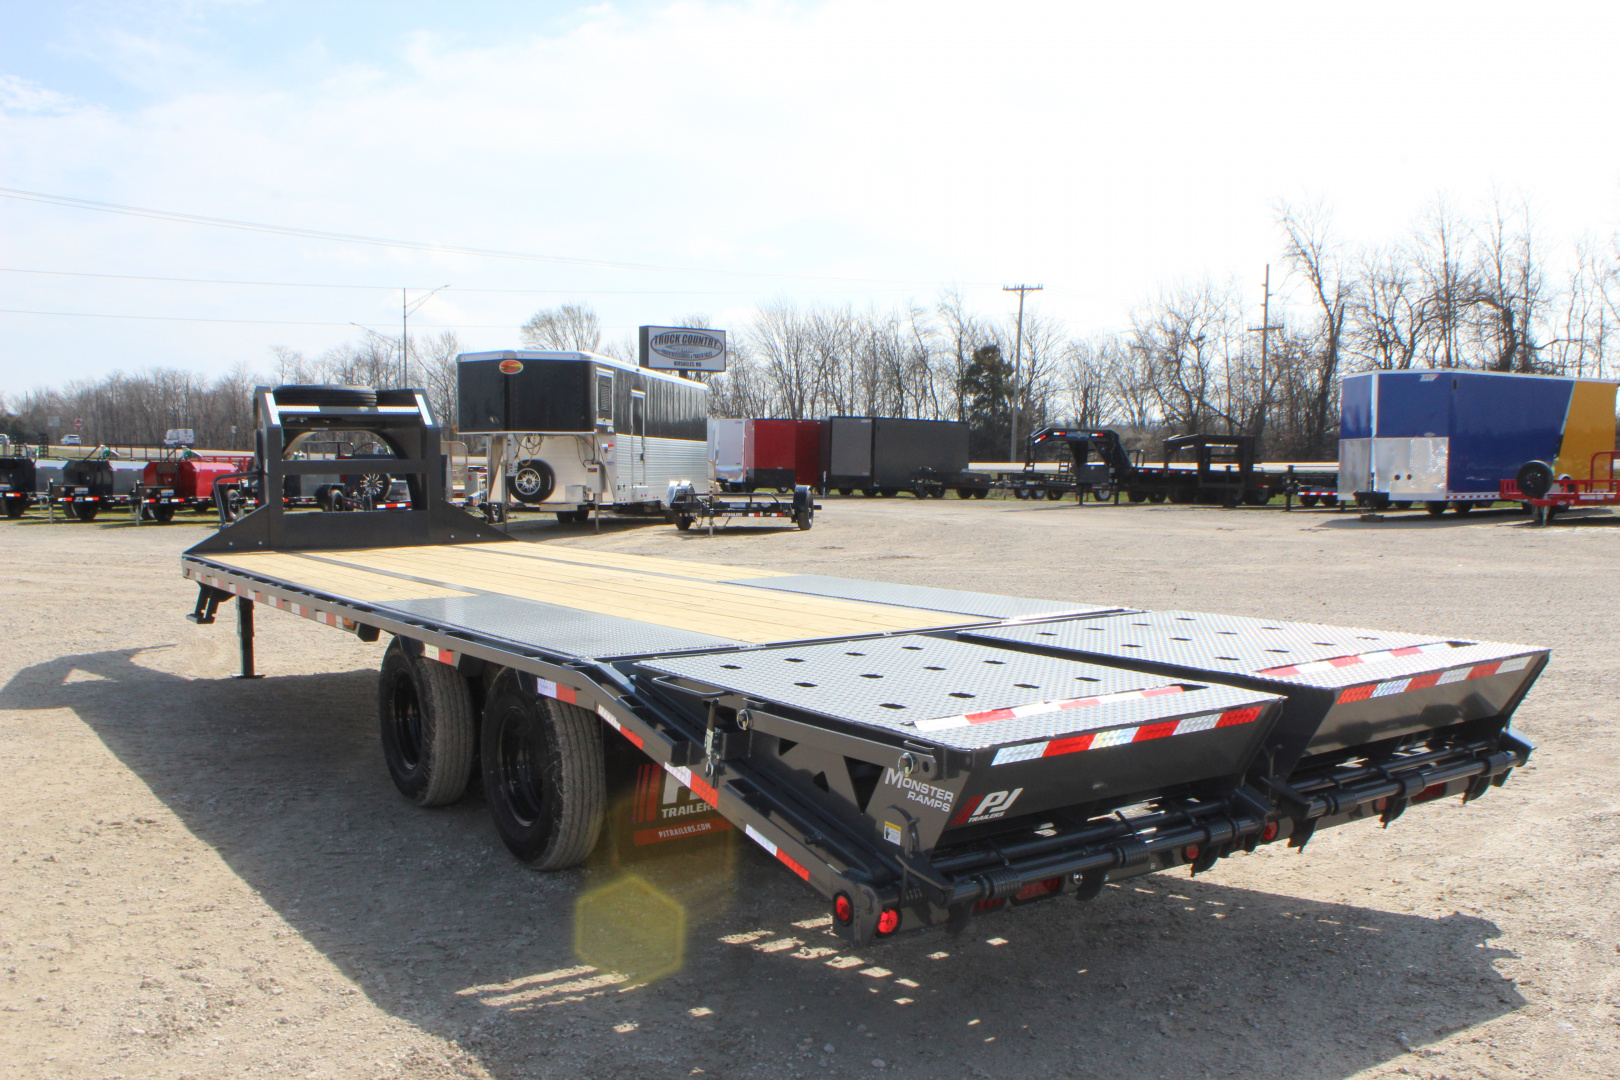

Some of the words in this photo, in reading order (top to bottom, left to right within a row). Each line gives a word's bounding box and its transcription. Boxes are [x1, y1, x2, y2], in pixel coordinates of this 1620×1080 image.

[654, 334, 681, 346] TRUCK
[682, 334, 719, 348] COUNTRY
[884, 767, 954, 803] MONSTER
[907, 791, 951, 813] RAMPS
[972, 787, 1024, 816] PJ
[661, 802, 715, 819] TRAILER
[968, 811, 1005, 823] TRAILERS
[658, 822, 712, 838] PJTRAILERS.COM
